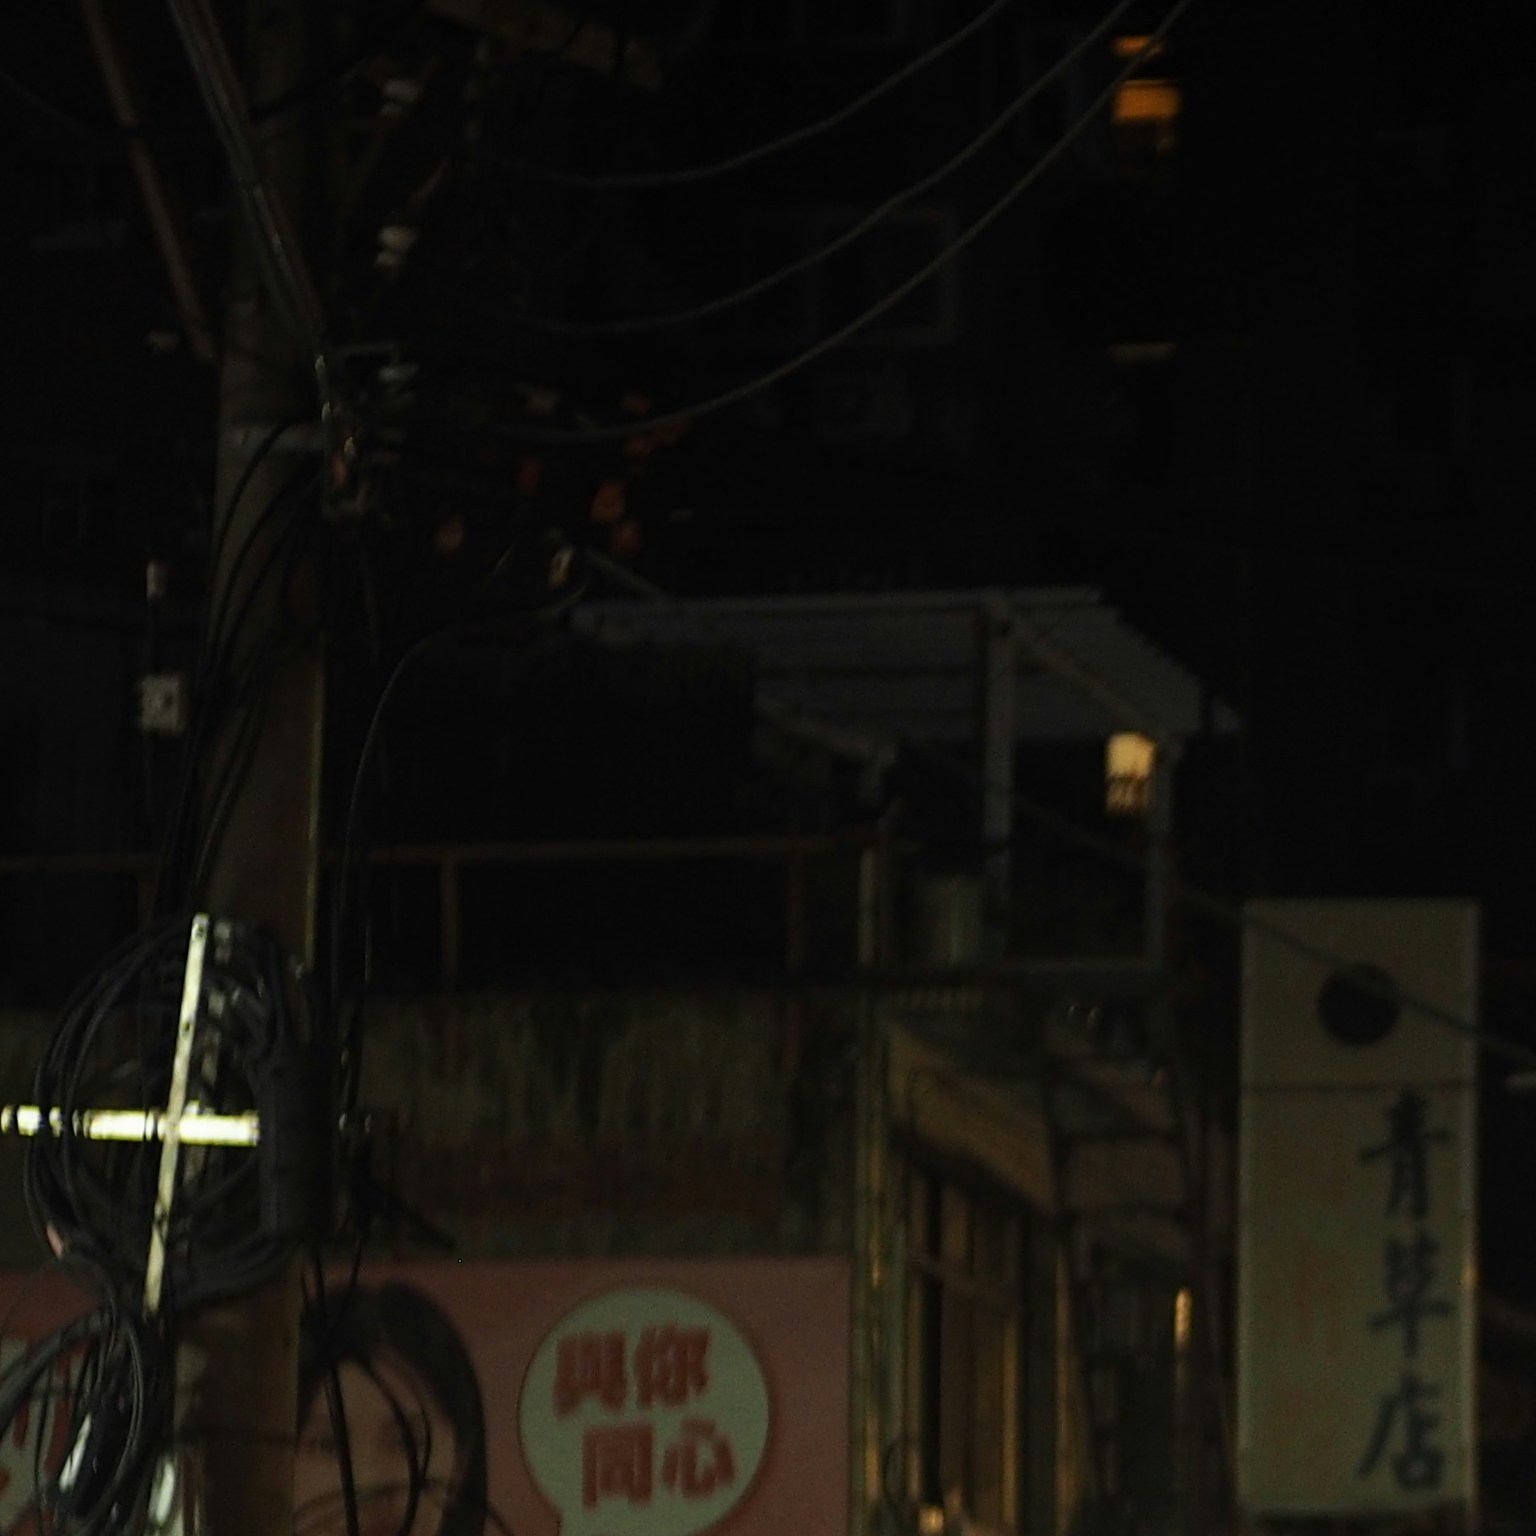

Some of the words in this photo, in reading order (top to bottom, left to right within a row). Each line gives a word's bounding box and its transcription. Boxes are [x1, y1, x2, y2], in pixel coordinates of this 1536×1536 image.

[1356, 1088, 1456, 1494] 青草店
[580, 1417, 738, 1509] 同心
